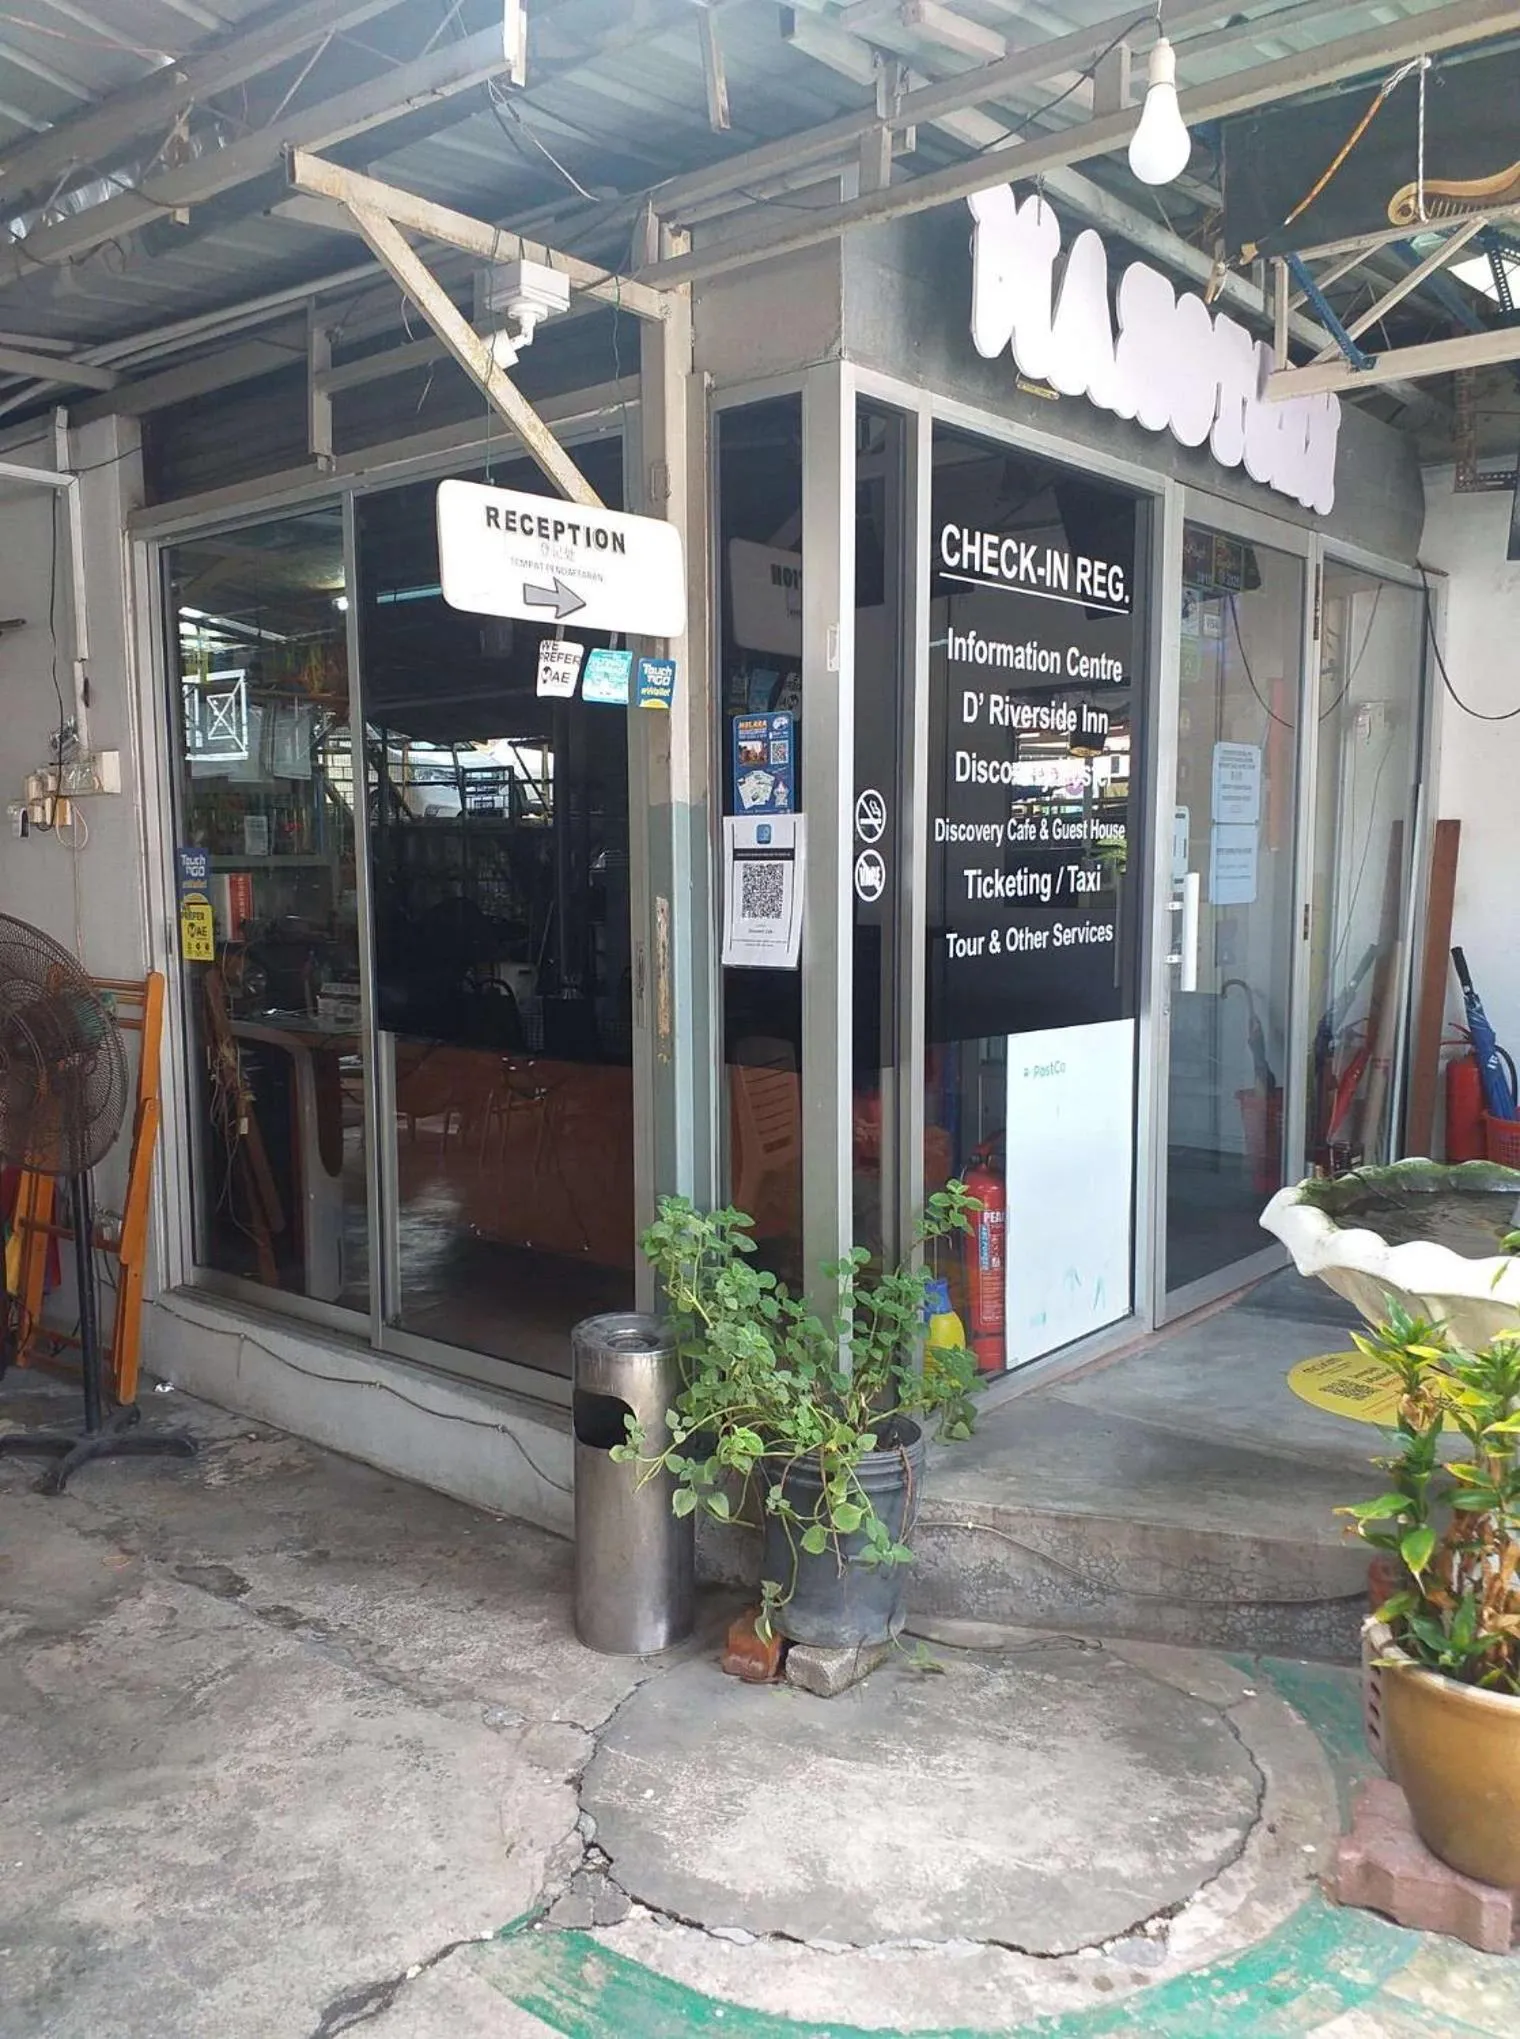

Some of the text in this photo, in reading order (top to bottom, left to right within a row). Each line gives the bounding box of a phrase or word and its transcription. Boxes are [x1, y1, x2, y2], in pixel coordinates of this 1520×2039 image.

[485, 505, 626, 555] RECEPTION
[940, 523, 1130, 604] CHECK-IN REG.
[642, 663, 673, 677] Touch
[948, 627, 1123, 682] Information Centre
[989, 694, 1077, 732] Riverside
[1082, 704, 1109, 735] Inn
[934, 818, 1126, 847] Discovery Cafe & Guest House
[180, 854, 206, 866] Touch
[964, 867, 1052, 901] Ticketing
[1067, 865, 1101, 893] Taxi
[946, 920, 1113, 958] Tour & Other Services
